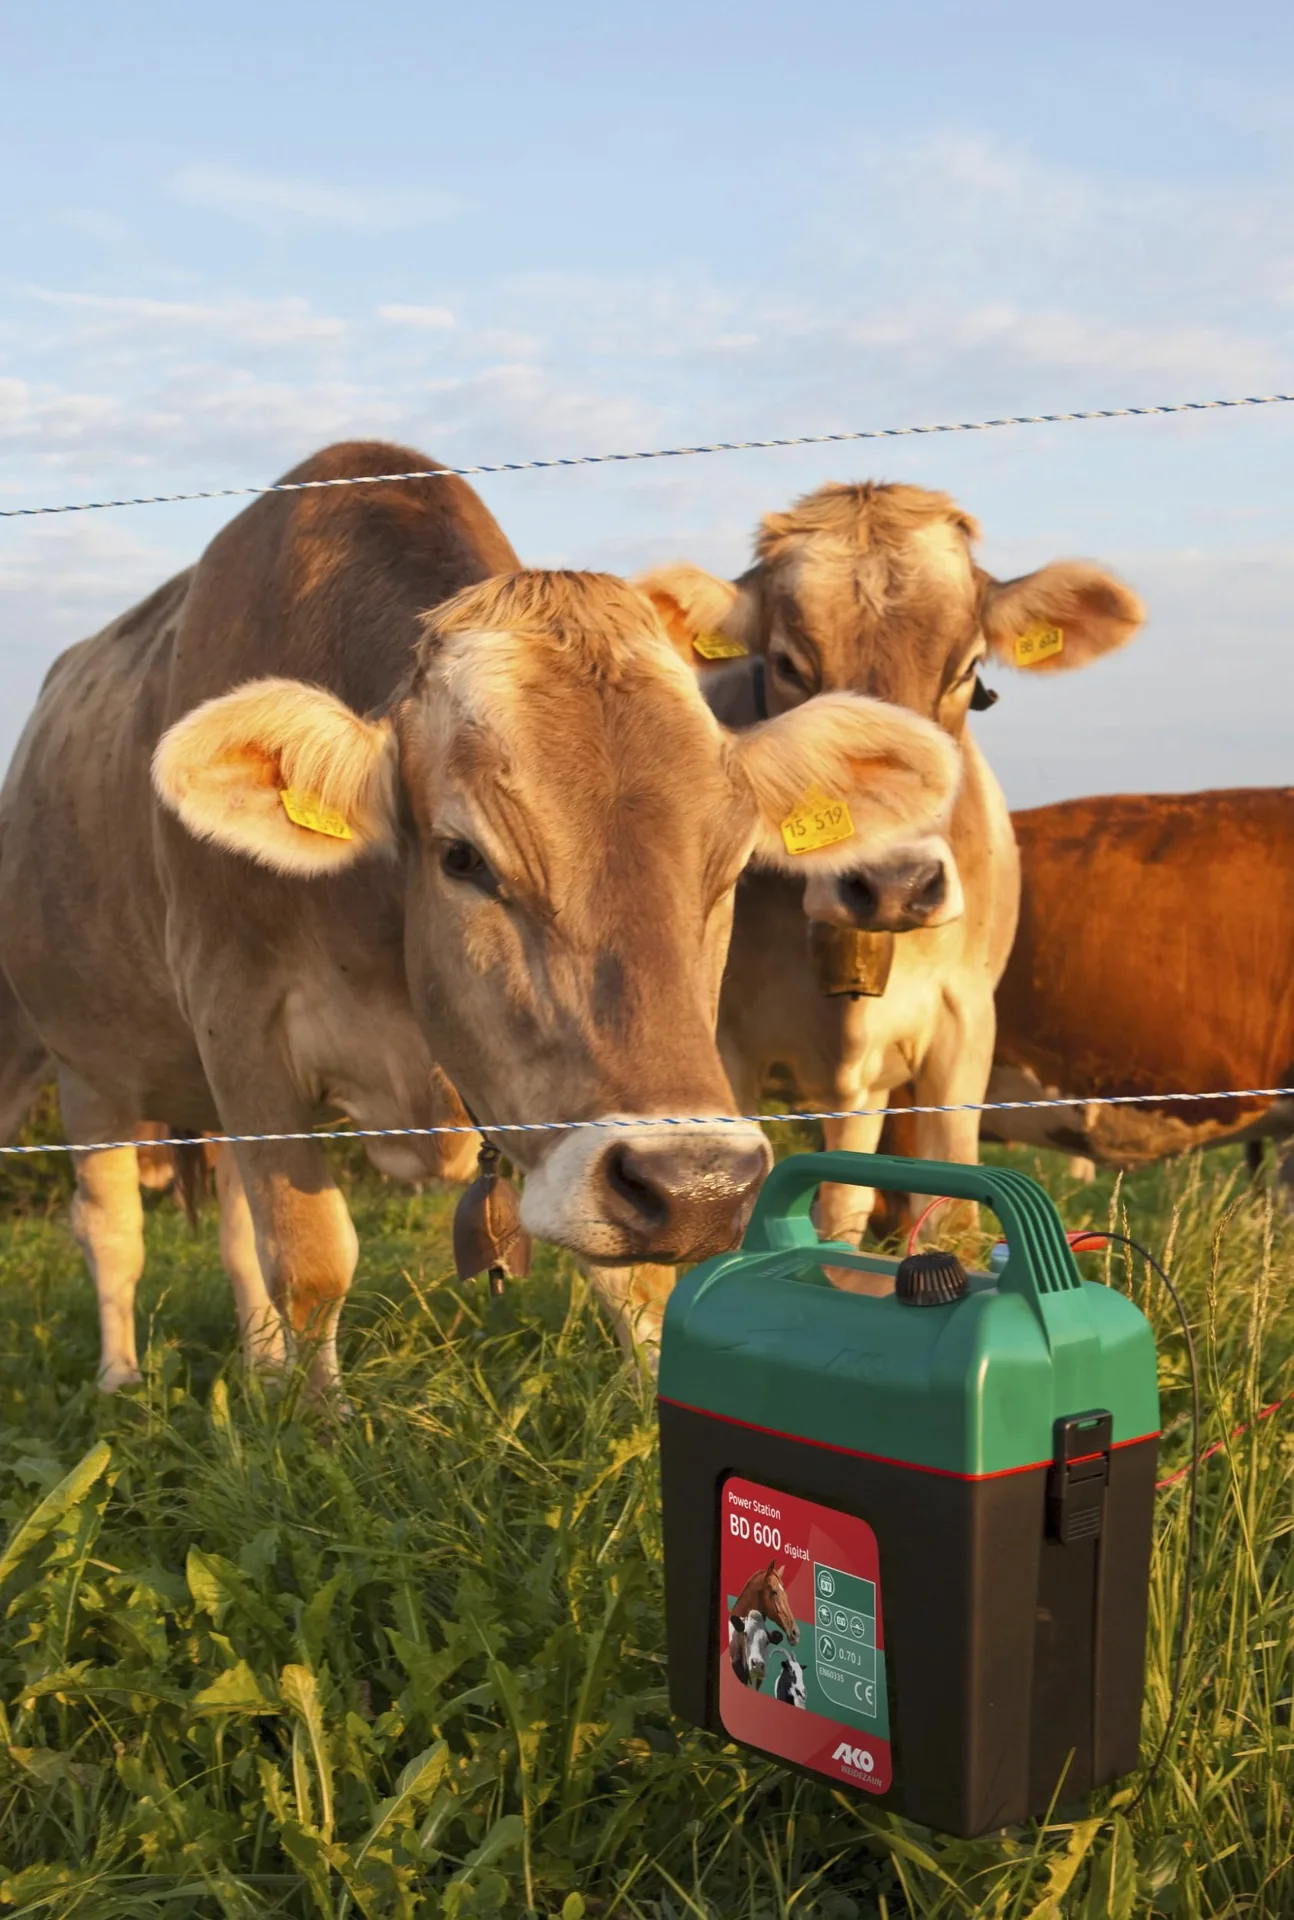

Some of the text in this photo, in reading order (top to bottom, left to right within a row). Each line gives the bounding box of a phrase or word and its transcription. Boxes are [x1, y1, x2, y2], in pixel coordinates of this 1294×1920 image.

[784, 806, 843, 838] 15 519
[728, 1492, 781, 1520] Power Station
[729, 1513, 810, 1561] BD 600 digital
[838, 1648, 856, 1664] 0.70
[854, 1681, 873, 1705] CE
[831, 1742, 874, 1773] AKO
[841, 1765, 882, 1788] WEIDEZAUN
